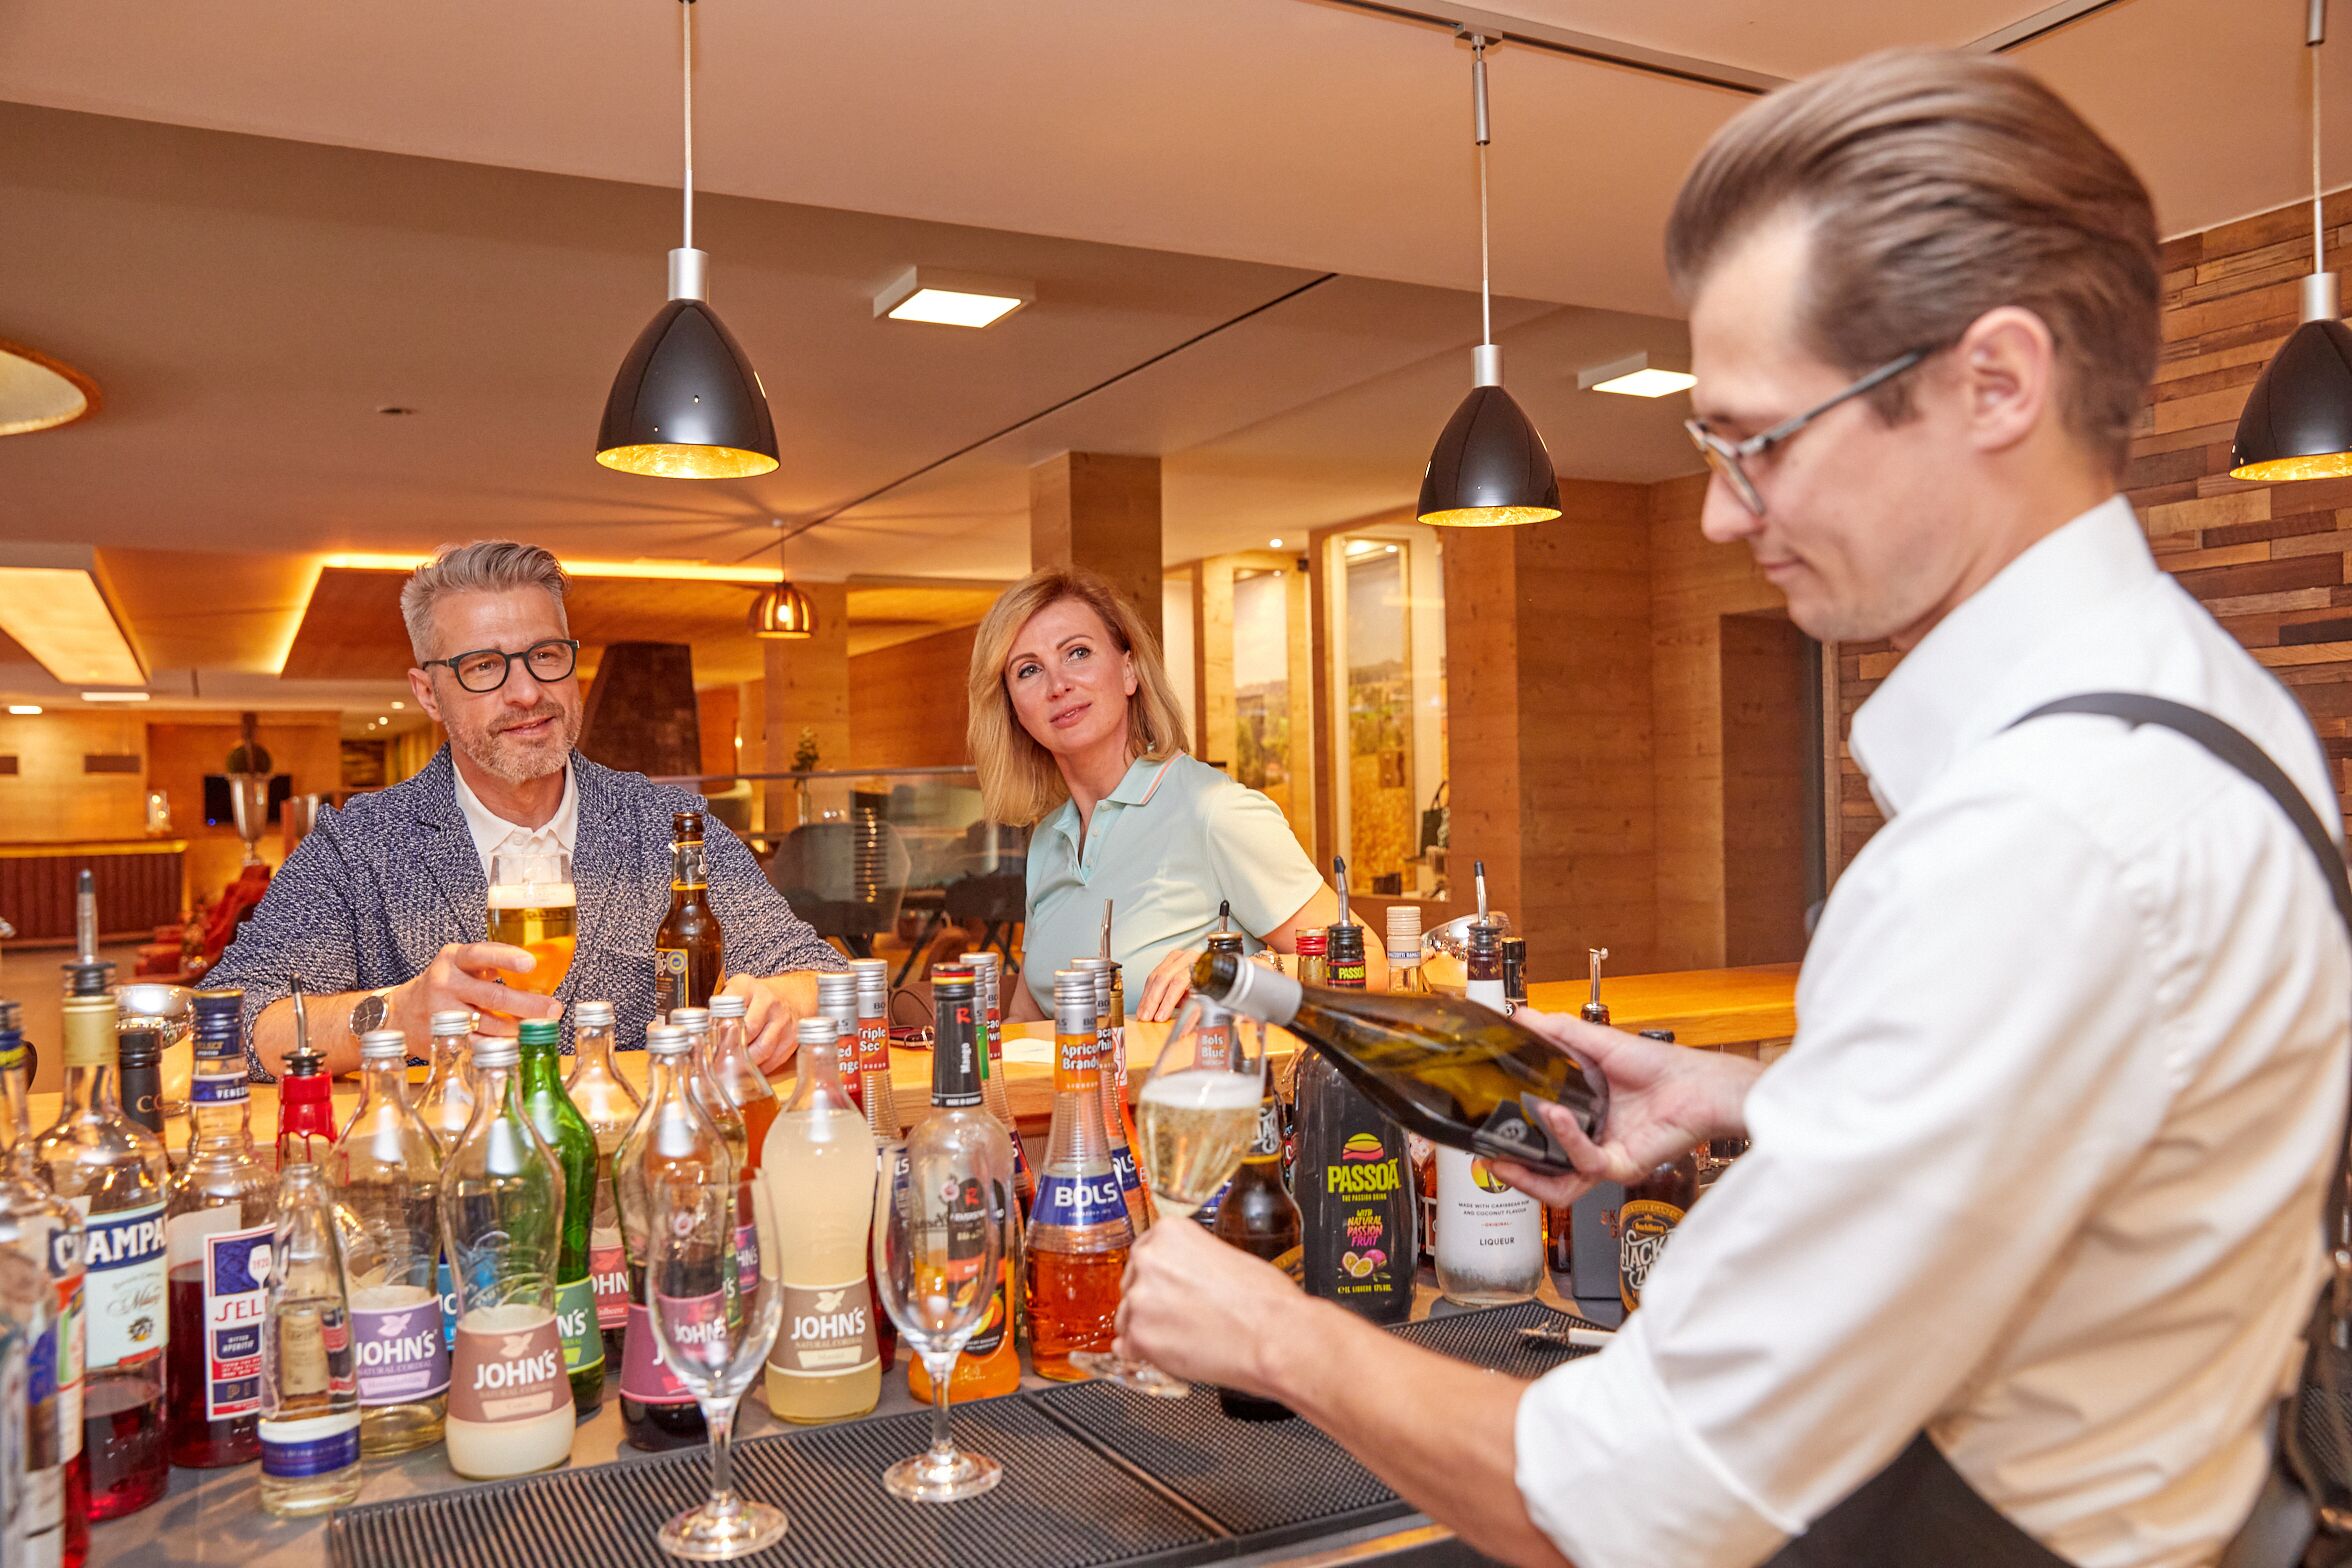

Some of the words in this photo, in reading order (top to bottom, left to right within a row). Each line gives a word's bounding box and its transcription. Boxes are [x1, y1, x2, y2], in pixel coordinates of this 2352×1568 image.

[1202, 1034, 1224, 1046] Bols
[859, 1041, 880, 1052] Sec
[1201, 1046, 1225, 1058] Blue
[1054, 1182, 1118, 1208] BOLS
[1356, 1208, 1373, 1217] WITH
[1347, 1216, 1382, 1227] NATURAL
[1346, 1224, 1384, 1238] PASSION
[54, 1214, 168, 1270] CAMPA
[1351, 1236, 1379, 1248] FRUIT
[1479, 1237, 1515, 1246] LIQUEUR
[790, 1306, 866, 1341] JOHN'S
[355, 1330, 436, 1367] JOHN'S
[473, 1349, 557, 1390] JOHN'S
